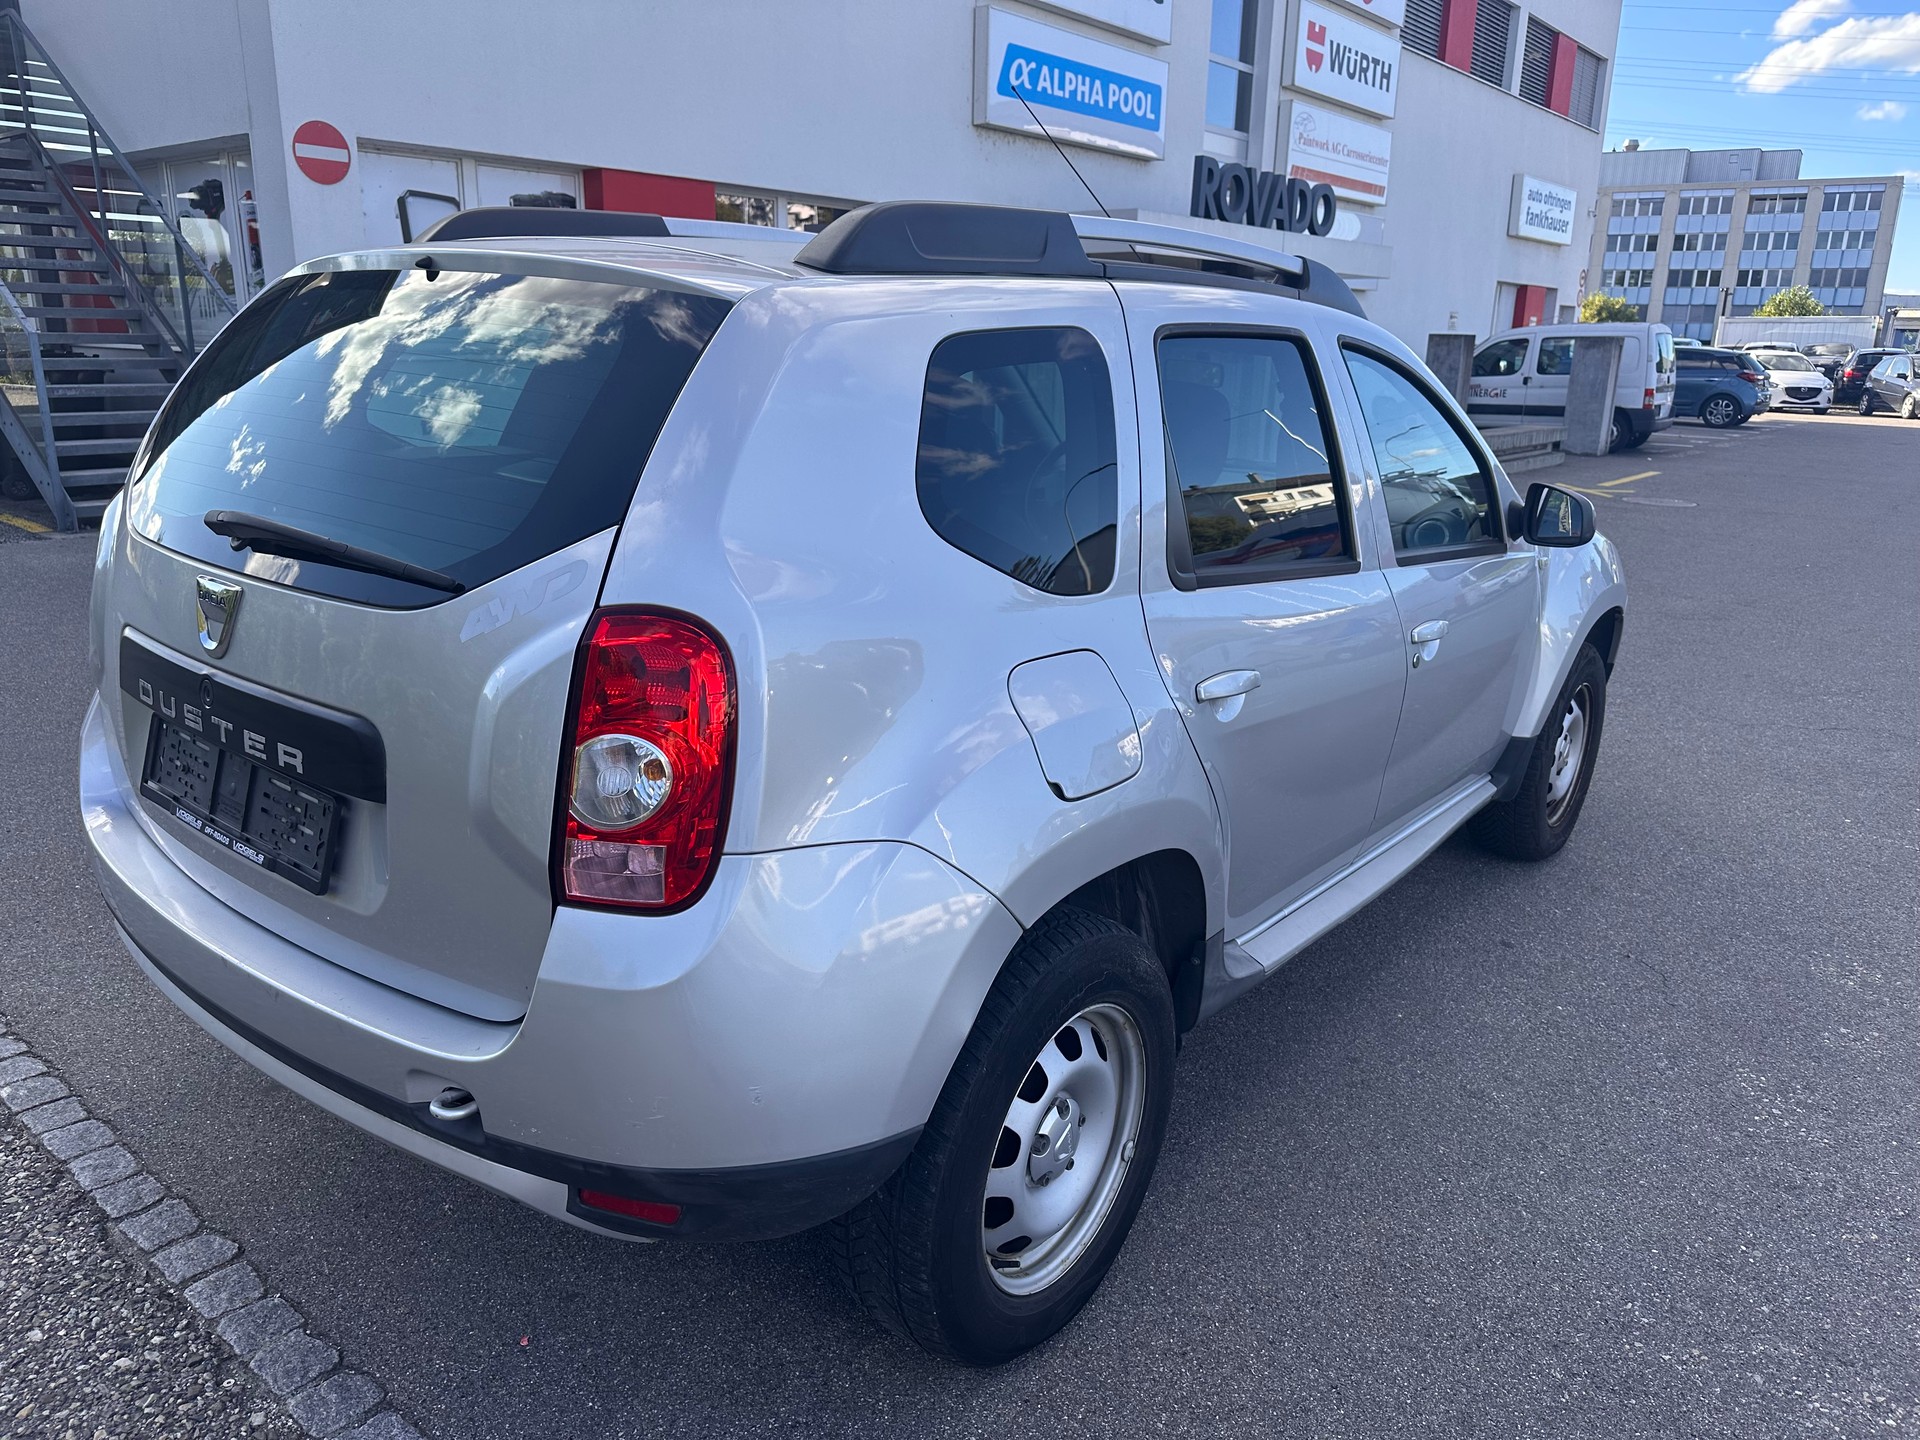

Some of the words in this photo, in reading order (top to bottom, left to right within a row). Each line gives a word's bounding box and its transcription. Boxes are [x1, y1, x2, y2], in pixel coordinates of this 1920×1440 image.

[1037, 65, 1104, 107] ALPHA
[1108, 83, 1156, 120] POOL
[1329, 39, 1392, 93] WÜRTH
[1298, 132, 1330, 153] Paintwork
[1330, 141, 1341, 155] AG
[1190, 155, 1336, 236] ROVADO
[1525, 206, 1569, 233] fankhauser
[1528, 189, 1543, 205] auto
[1544, 191, 1571, 213] oftringen
[199, 589, 226, 607] DACIA
[460, 559, 588, 643] 4WD
[138, 678, 303, 774] DUSTER
[176, 807, 203, 827] VOGELS
[232, 839, 264, 862] VOGELS
